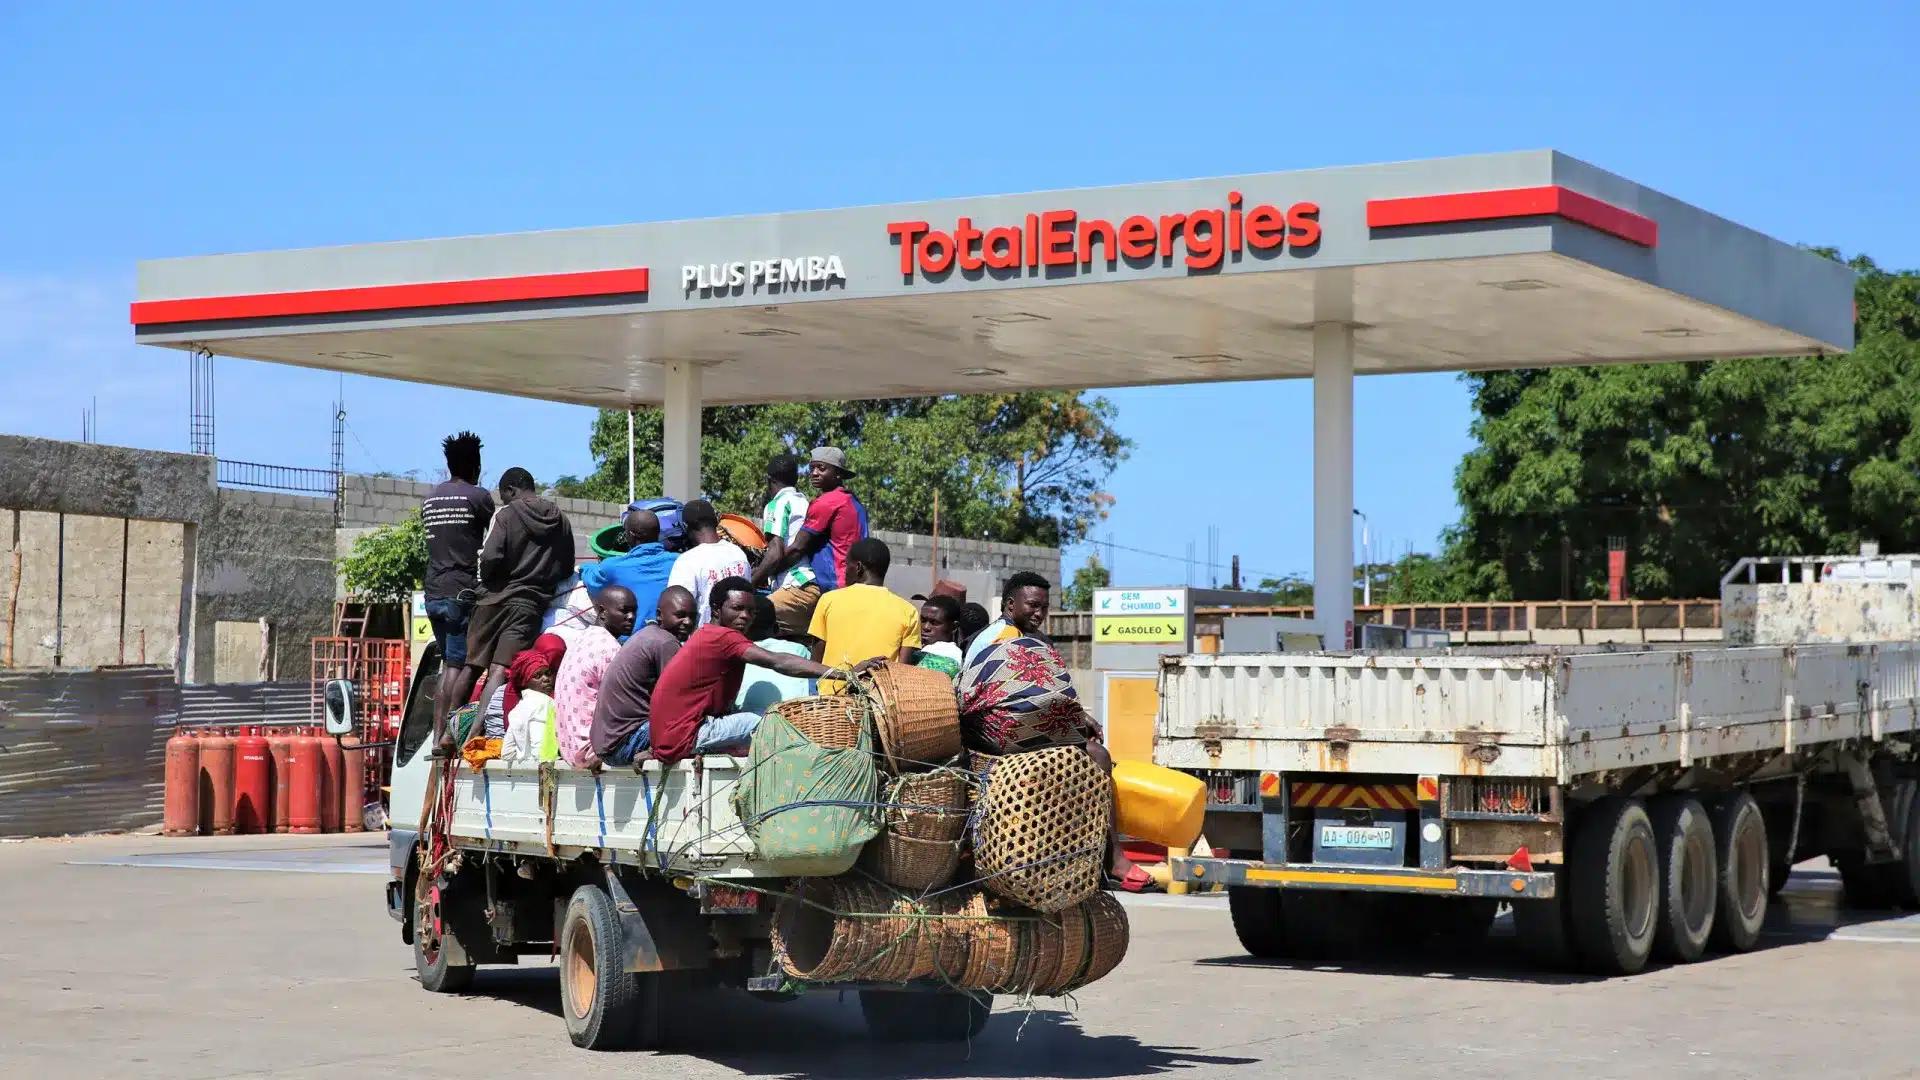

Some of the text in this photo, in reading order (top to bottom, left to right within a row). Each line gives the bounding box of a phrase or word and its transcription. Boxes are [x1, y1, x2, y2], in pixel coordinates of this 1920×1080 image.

[887, 191, 1321, 269] TotalEnergies
[682, 255, 846, 289] PLUS PEMBA
[1121, 592, 1140, 600] SEM
[1121, 602, 1161, 610] CHUMBO
